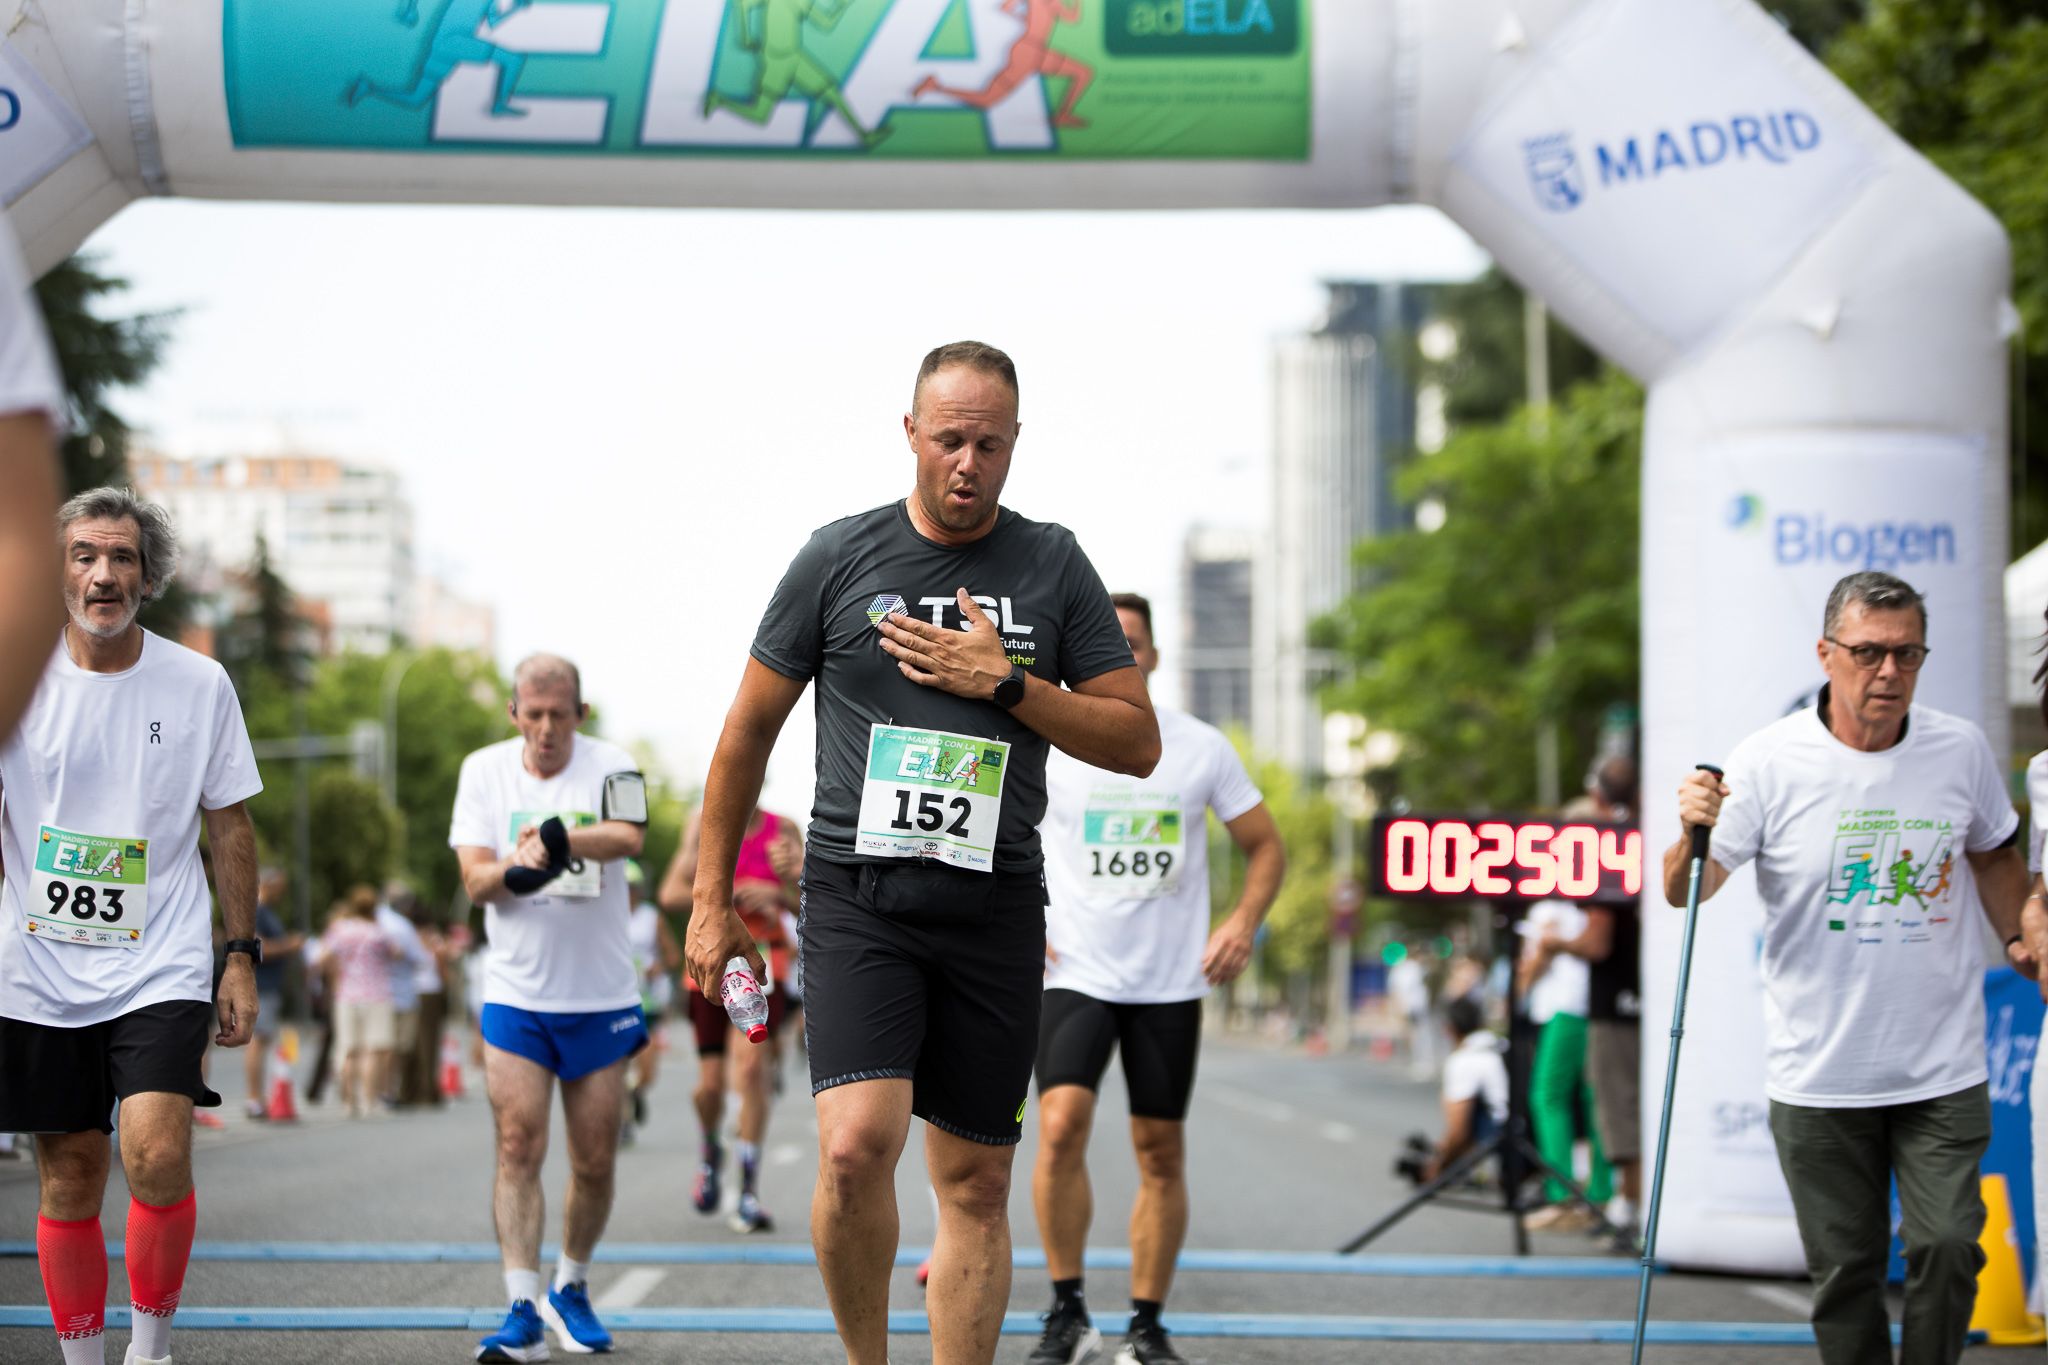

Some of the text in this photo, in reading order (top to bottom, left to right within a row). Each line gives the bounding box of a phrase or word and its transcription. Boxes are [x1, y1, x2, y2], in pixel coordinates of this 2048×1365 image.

[1595, 110, 1822, 187] MADRID
[1773, 512, 1957, 572] Biogen
[918, 595, 1034, 635] TSL
[907, 735, 943, 746] MADRID
[944, 739, 963, 749] CON
[965, 743, 976, 751] LA
[896, 743, 977, 788] ELA
[891, 790, 971, 838] 152
[1837, 818, 1952, 832] MADRID CON LA
[53, 840, 122, 878] ELA
[1092, 850, 1174, 878] 1689
[1827, 832, 1952, 893] ELA
[47, 881, 124, 923] 983
